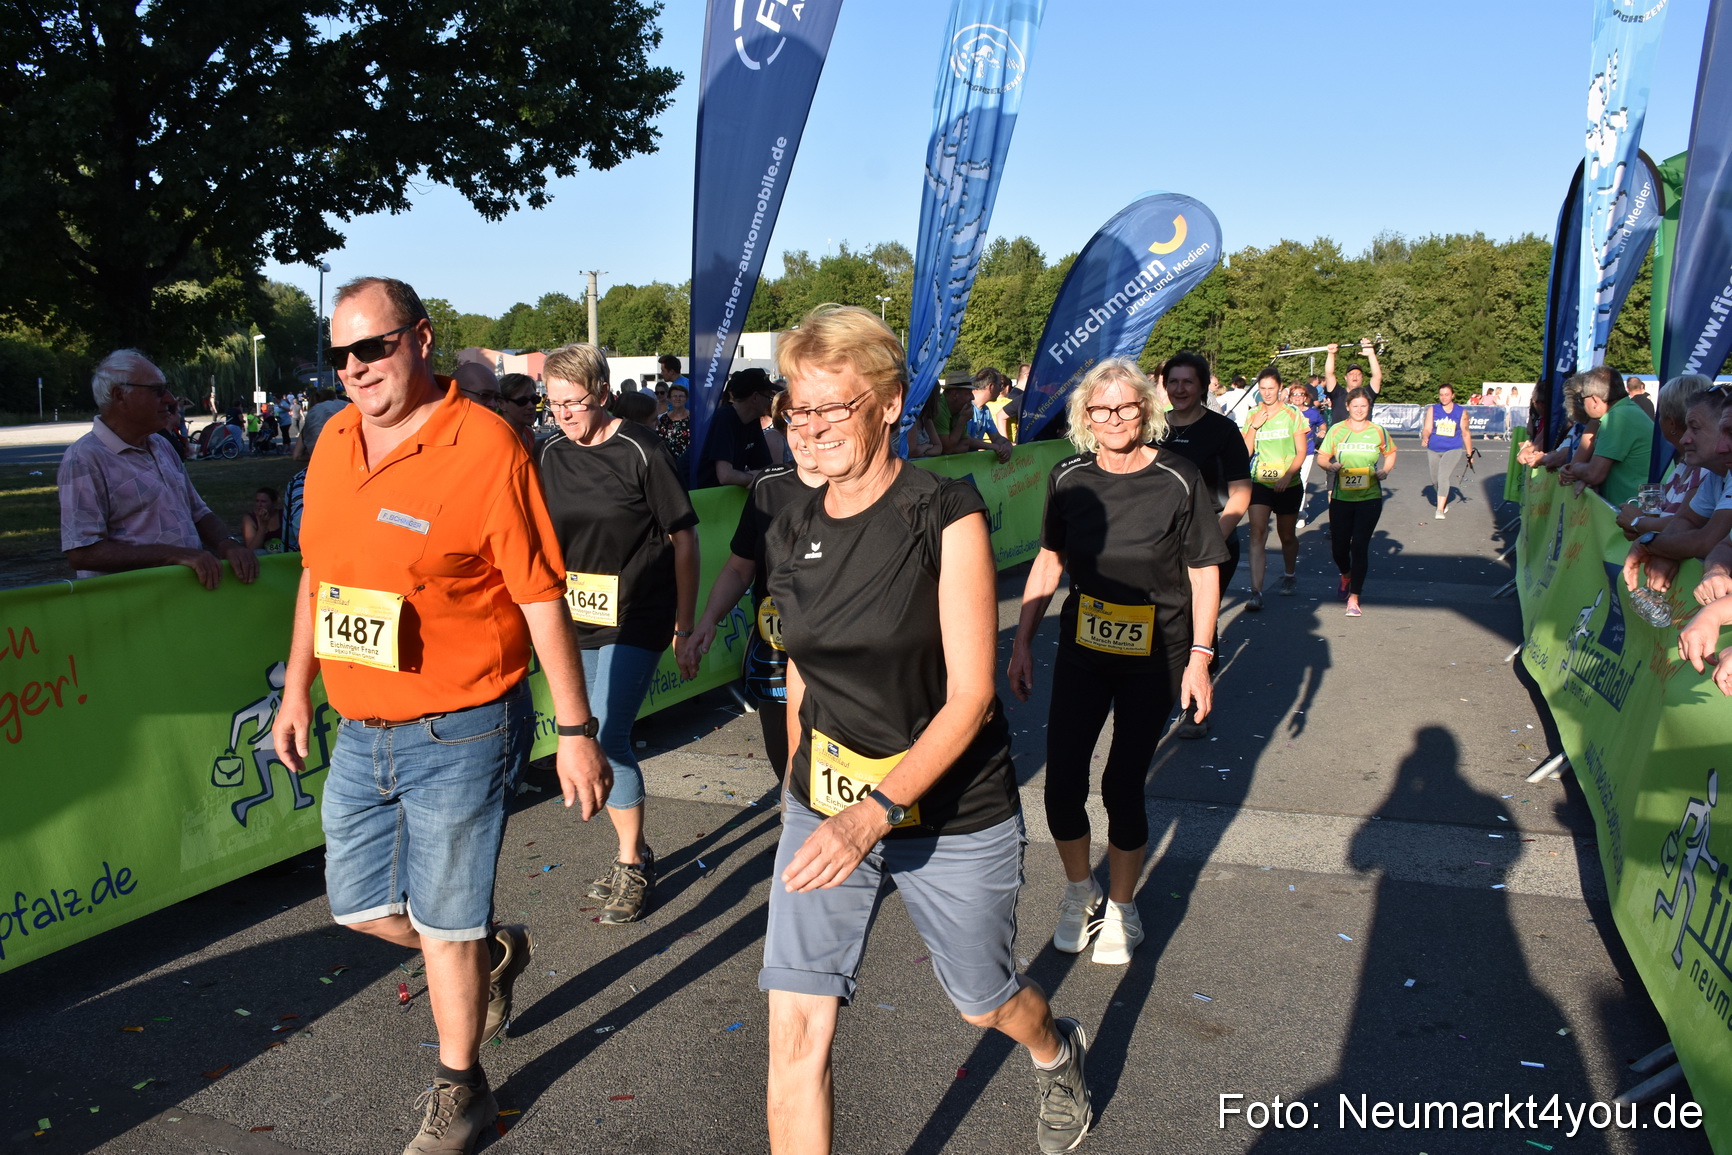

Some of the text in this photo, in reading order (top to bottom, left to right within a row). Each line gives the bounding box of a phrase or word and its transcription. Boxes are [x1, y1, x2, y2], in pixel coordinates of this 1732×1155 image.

[703, 136, 787, 389] www.fischer-automobile.de
[1125, 241, 1210, 316] Druck und Medien
[1049, 258, 1167, 366] Frischmann
[1262, 470, 1278, 478] 229
[1345, 476, 1362, 485] 227
[569, 590, 608, 611] 1642
[324, 612, 385, 647] 1487
[1087, 616, 1142, 642] 1675
[1091, 636, 1112, 645] Marsch
[330, 641, 379, 656] Eichinger Franz
